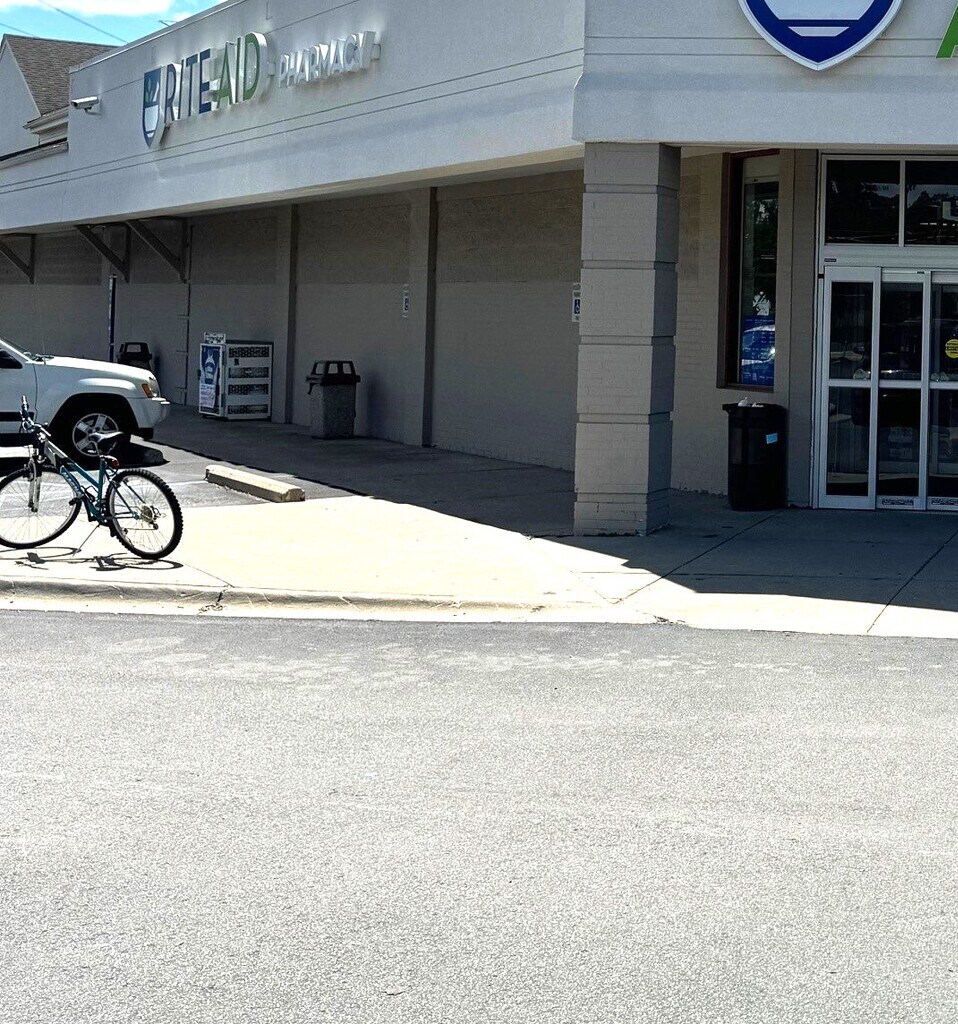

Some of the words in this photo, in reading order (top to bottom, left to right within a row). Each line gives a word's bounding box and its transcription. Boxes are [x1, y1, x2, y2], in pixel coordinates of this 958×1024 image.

[164, 48, 212, 123] RITE
[216, 32, 265, 110] AID
[277, 30, 377, 89] PHARMACY
